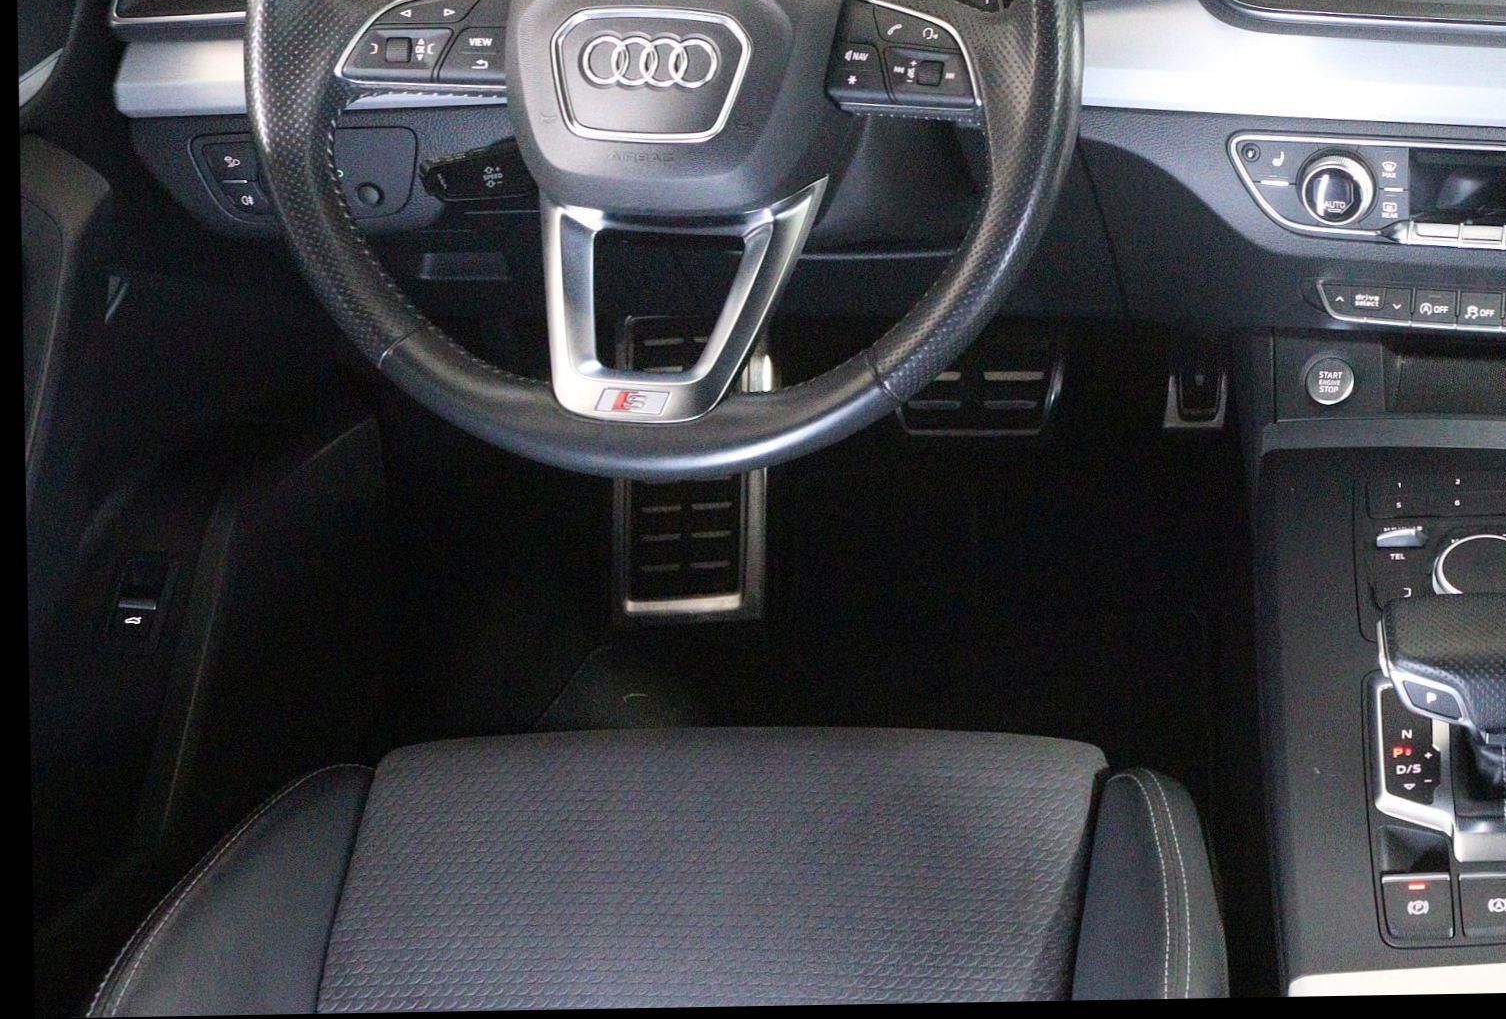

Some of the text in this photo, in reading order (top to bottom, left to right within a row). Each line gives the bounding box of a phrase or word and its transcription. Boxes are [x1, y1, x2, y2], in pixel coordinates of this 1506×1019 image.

[468, 37, 493, 47] VIEW
[852, 52, 869, 61] NAV
[1323, 200, 1346, 210] AUTO
[1355, 293, 1380, 301] drive
[1433, 304, 1449, 314] OFF
[1480, 308, 1496, 318] OFF
[1318, 370, 1343, 379] START
[1319, 385, 1339, 394] STOP
[1389, 553, 1406, 561] TEL
[1426, 691, 1437, 704] P
[1401, 729, 1413, 740] N
[1396, 763, 1422, 775] D/S
